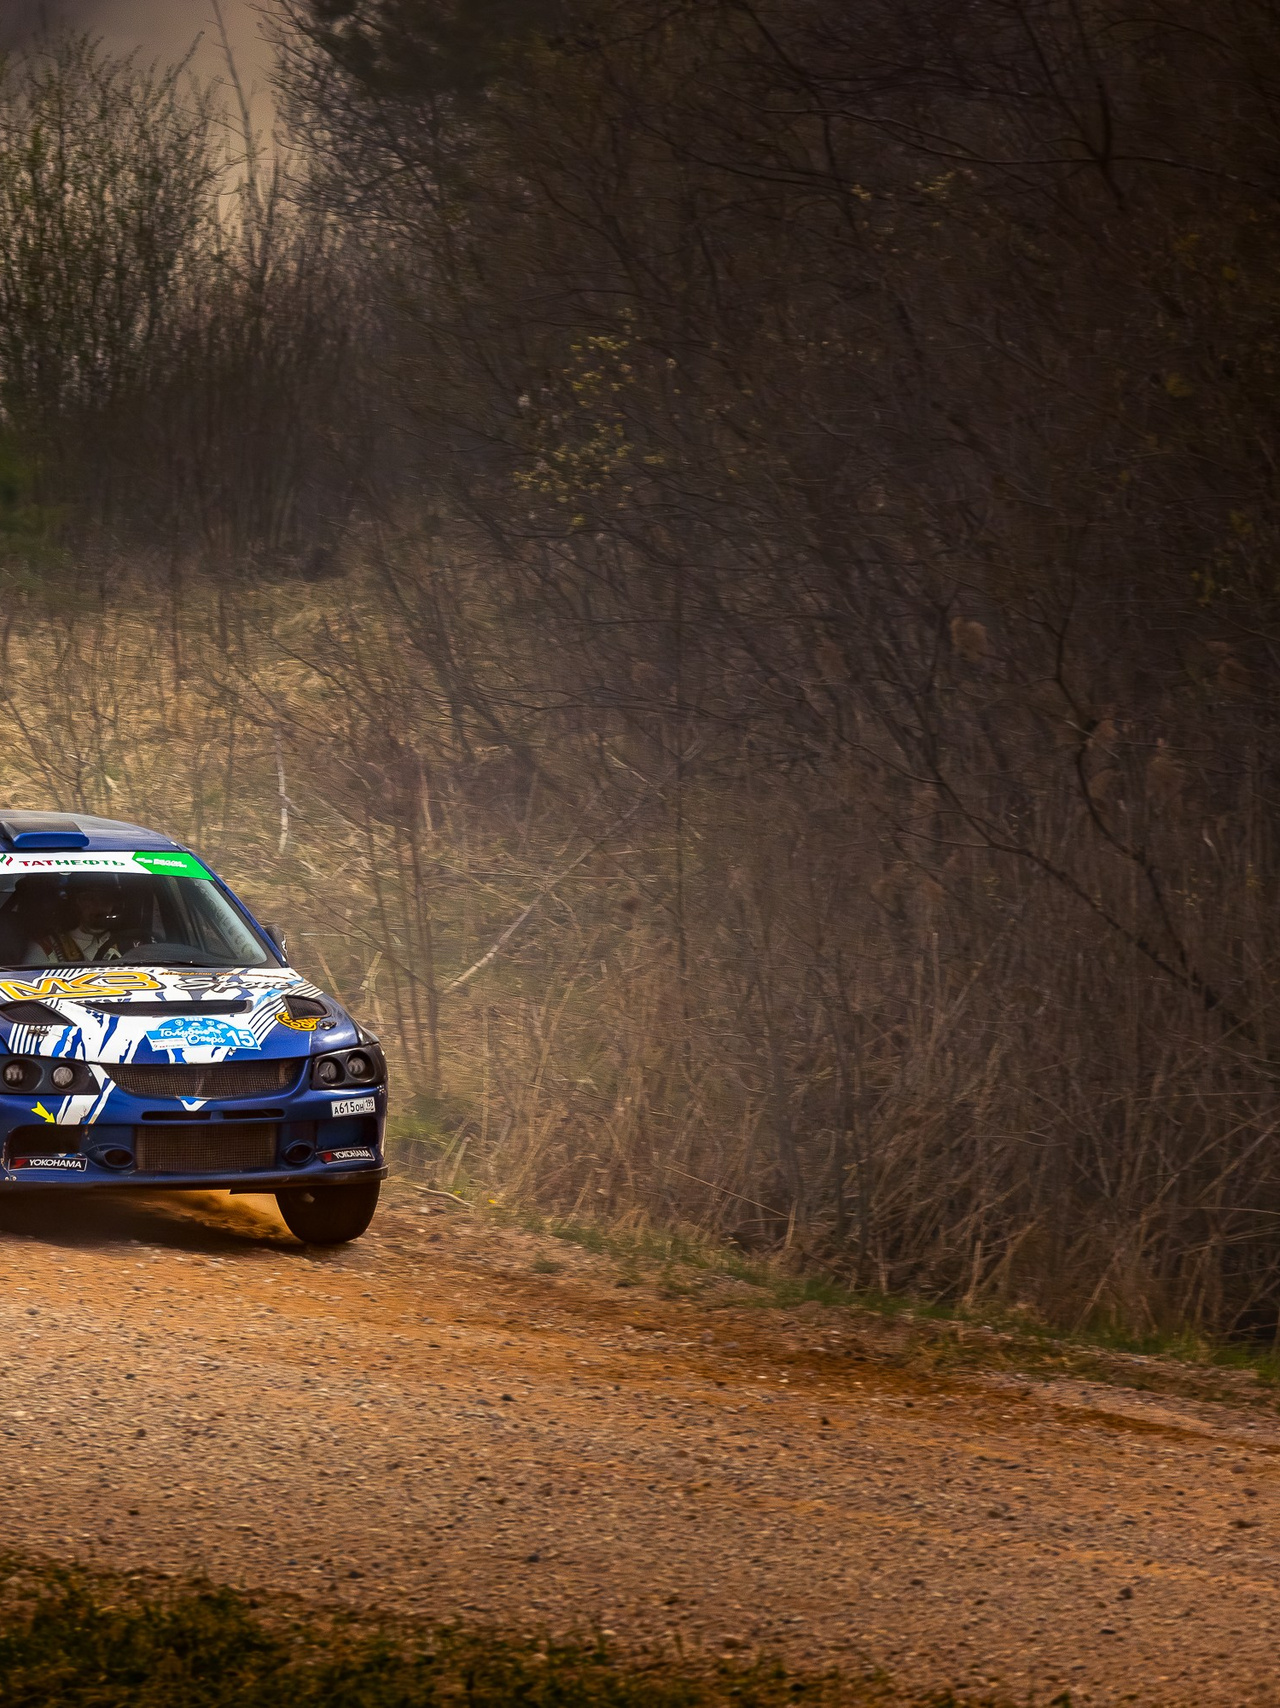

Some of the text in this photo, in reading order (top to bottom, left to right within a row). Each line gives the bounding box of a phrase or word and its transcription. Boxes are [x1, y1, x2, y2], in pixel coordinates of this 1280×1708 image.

[18, 859, 126, 867] ТАТНЕФТЬ
[173, 976, 290, 993] Sport
[227, 1030, 255, 1047] 15
[332, 1149, 372, 1160] YOKOHAMA
[29, 1159, 82, 1169] YOKOHAMA
